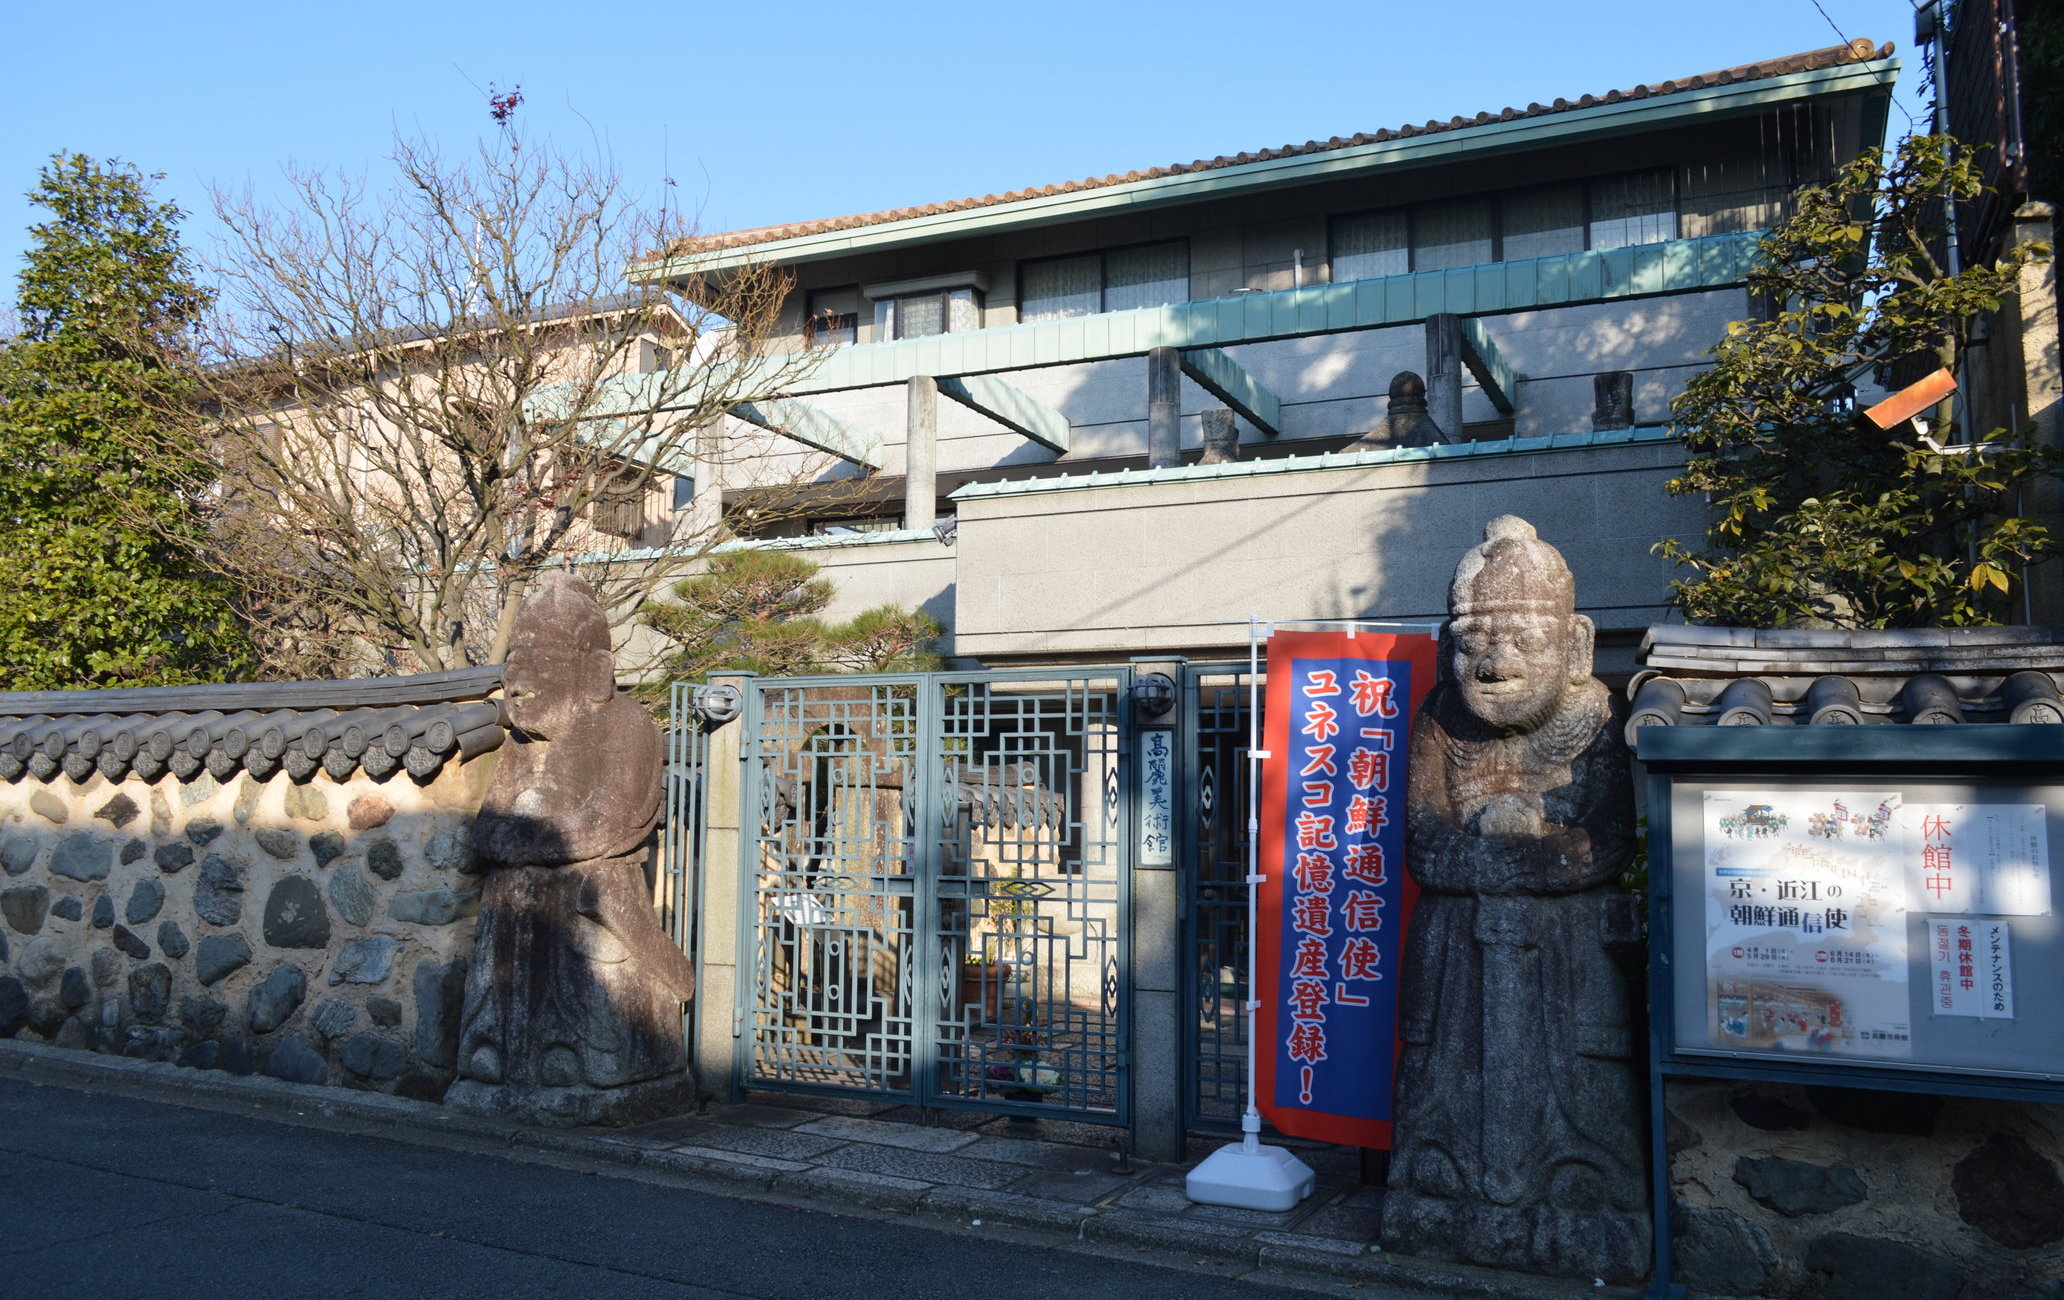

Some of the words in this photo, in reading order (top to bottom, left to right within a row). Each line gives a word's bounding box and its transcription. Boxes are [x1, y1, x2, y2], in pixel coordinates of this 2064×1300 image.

[1335, 669, 1399, 1008] 祝「朝鮮通信使」
[1919, 814, 1953, 900] 休館中
[1729, 877, 1842, 901] 京・近江の
[1729, 904, 1848, 934] 朝鮮通信使
[1937, 924, 1951, 963] 동절기
[1957, 925, 1974, 991] 冬期休館中
[1990, 926, 2005, 1012] メンテナンスのため
[1938, 970, 1953, 1009] 휴관중
